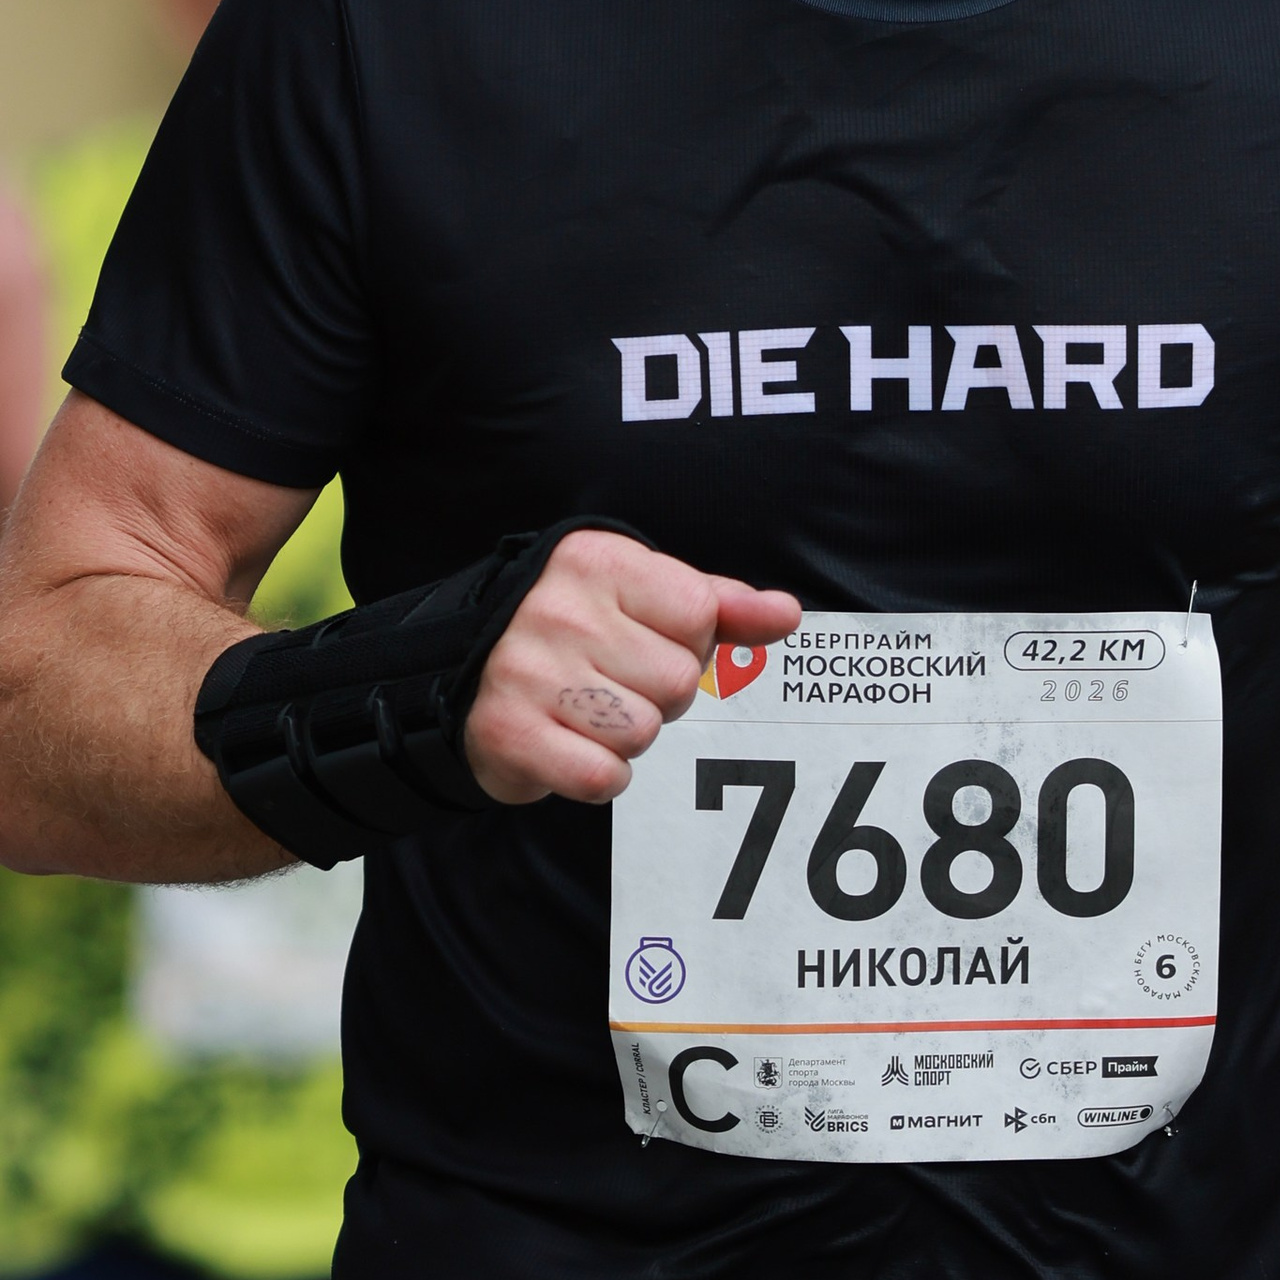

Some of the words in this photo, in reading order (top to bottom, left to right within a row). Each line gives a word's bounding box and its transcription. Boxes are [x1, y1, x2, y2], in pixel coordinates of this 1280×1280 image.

[610, 326, 817, 422] DIE
[838, 323, 1216, 412] HARD
[784, 630, 932, 650] СБЕРПРАЙМ
[1021, 639, 1086, 666] 42,2
[783, 650, 986, 678] МОСКОВСКИЙ
[783, 681, 932, 704] МАРАФОН
[1040, 679, 1130, 703] 2026
[694, 757, 1136, 922] 7680
[798, 936, 1030, 989] НИКОЛАЙ
[1155, 954, 1177, 979] 6
[788, 1058, 846, 1067] Департамент
[914, 1050, 994, 1070] МОСКОВСКИЙ
[1046, 1061, 1097, 1075] СБЕР
[1107, 1060, 1148, 1073] Прайм
[788, 1069, 819, 1077] спорта
[914, 1071, 951, 1086] СПОРТ
[669, 1046, 741, 1133] C
[788, 1080, 819, 1088] города
[821, 1079, 856, 1087] Москвы
[908, 1114, 983, 1129] магнит
[1031, 1114, 1056, 1124] сбп
[1084, 1110, 1139, 1122] WINLINE
[827, 1121, 869, 1132] BRICS
